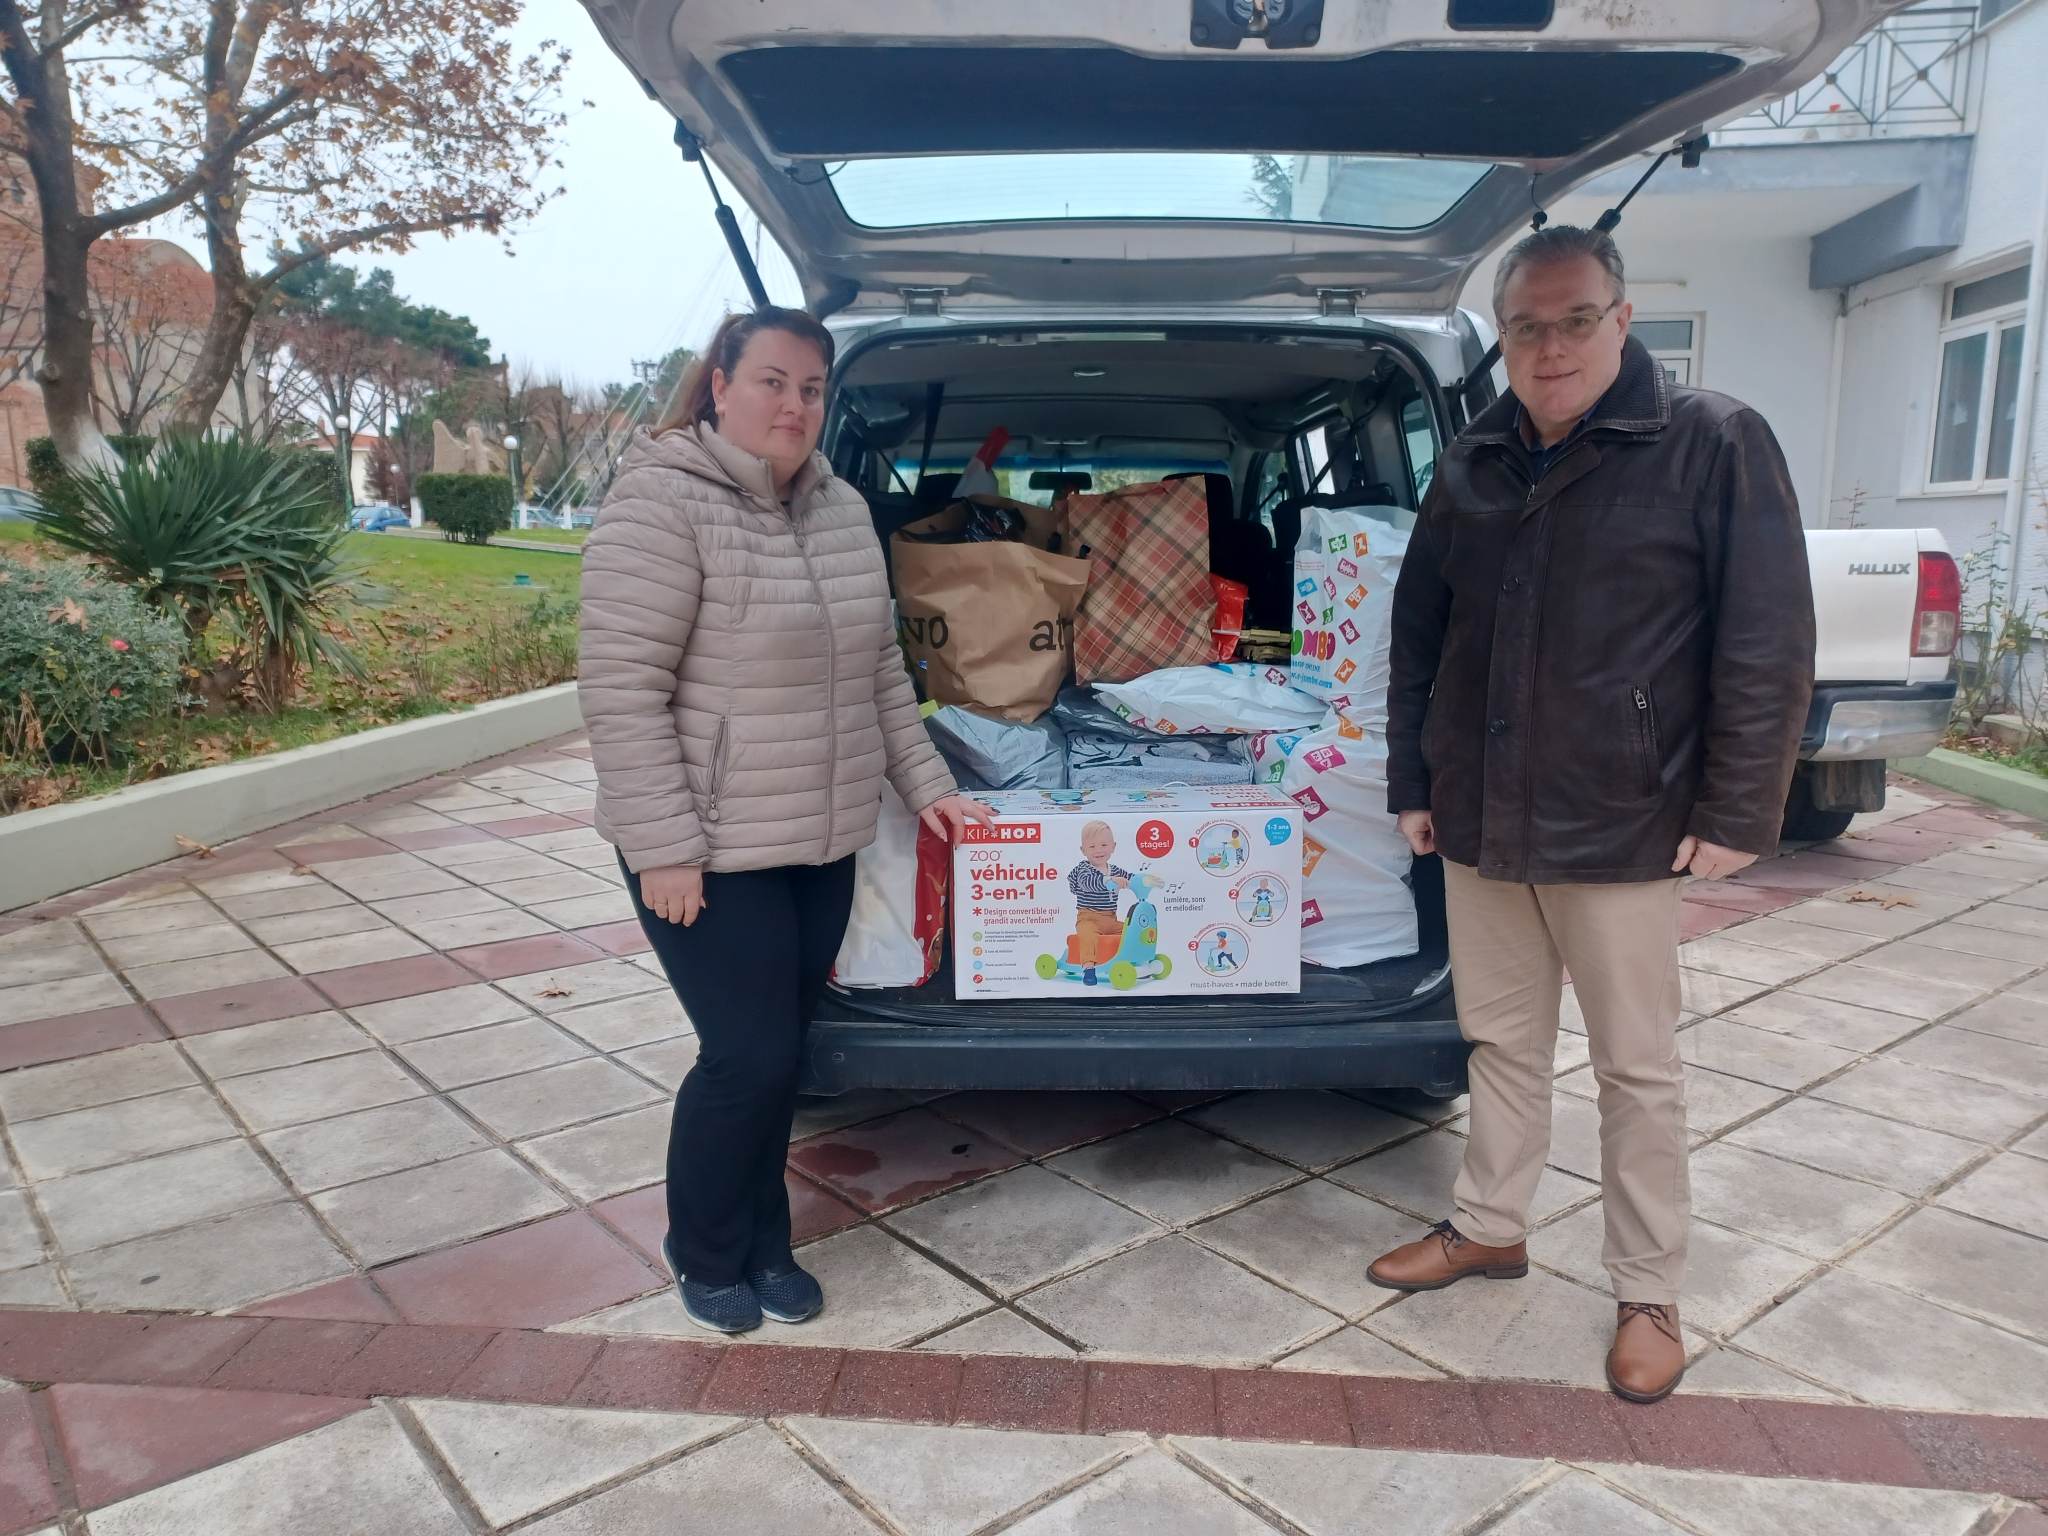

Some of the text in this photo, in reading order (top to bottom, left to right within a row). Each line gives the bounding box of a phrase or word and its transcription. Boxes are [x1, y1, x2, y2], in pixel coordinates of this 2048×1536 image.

[1848, 563, 1911, 576] HILUX
[962, 828, 990, 840] KIP
[1149, 827, 1160, 840] 3
[1140, 840, 1171, 850] stages!
[970, 850, 1001, 862] ZOO
[970, 863, 1058, 881] véhicule
[971, 884, 1035, 900] 3-en-1
[983, 907, 1060, 916] Design convertible qui
[983, 917, 1008, 926] grandit
